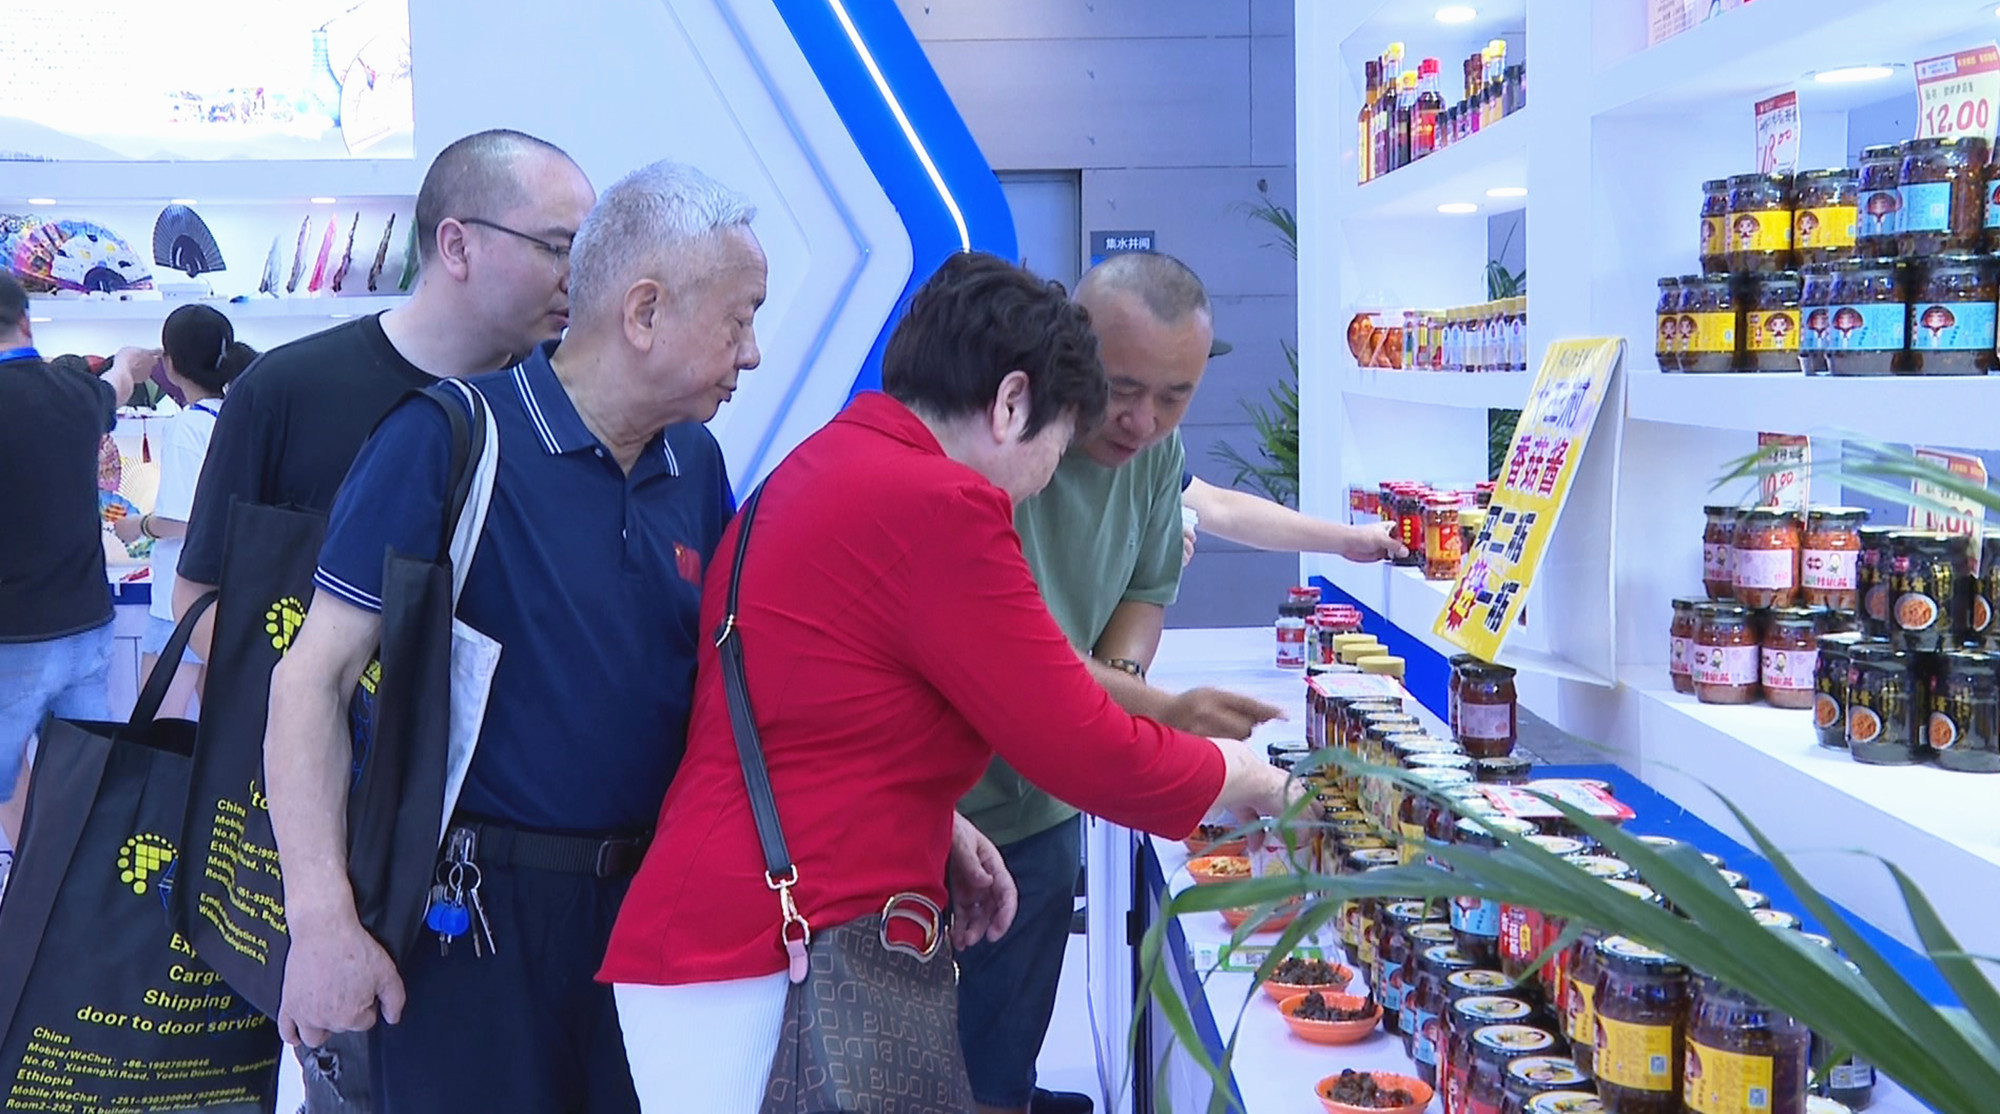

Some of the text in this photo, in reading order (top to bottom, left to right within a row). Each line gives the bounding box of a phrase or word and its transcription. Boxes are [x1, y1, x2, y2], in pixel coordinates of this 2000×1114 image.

[1926, 98, 1989, 136] 12.00
[1106, 237, 1150, 250] 集水井间
[1505, 436, 1570, 495] 香菇酱
[1475, 505, 1537, 564] 买二瓶
[143, 988, 231, 1012] Shipping
[77, 1005, 127, 1026] door
[133, 1015, 153, 1032] to
[158, 1019, 204, 1035] door
[33, 1026, 71, 1044] China
[17, 1068, 74, 1086] Ethiopia
